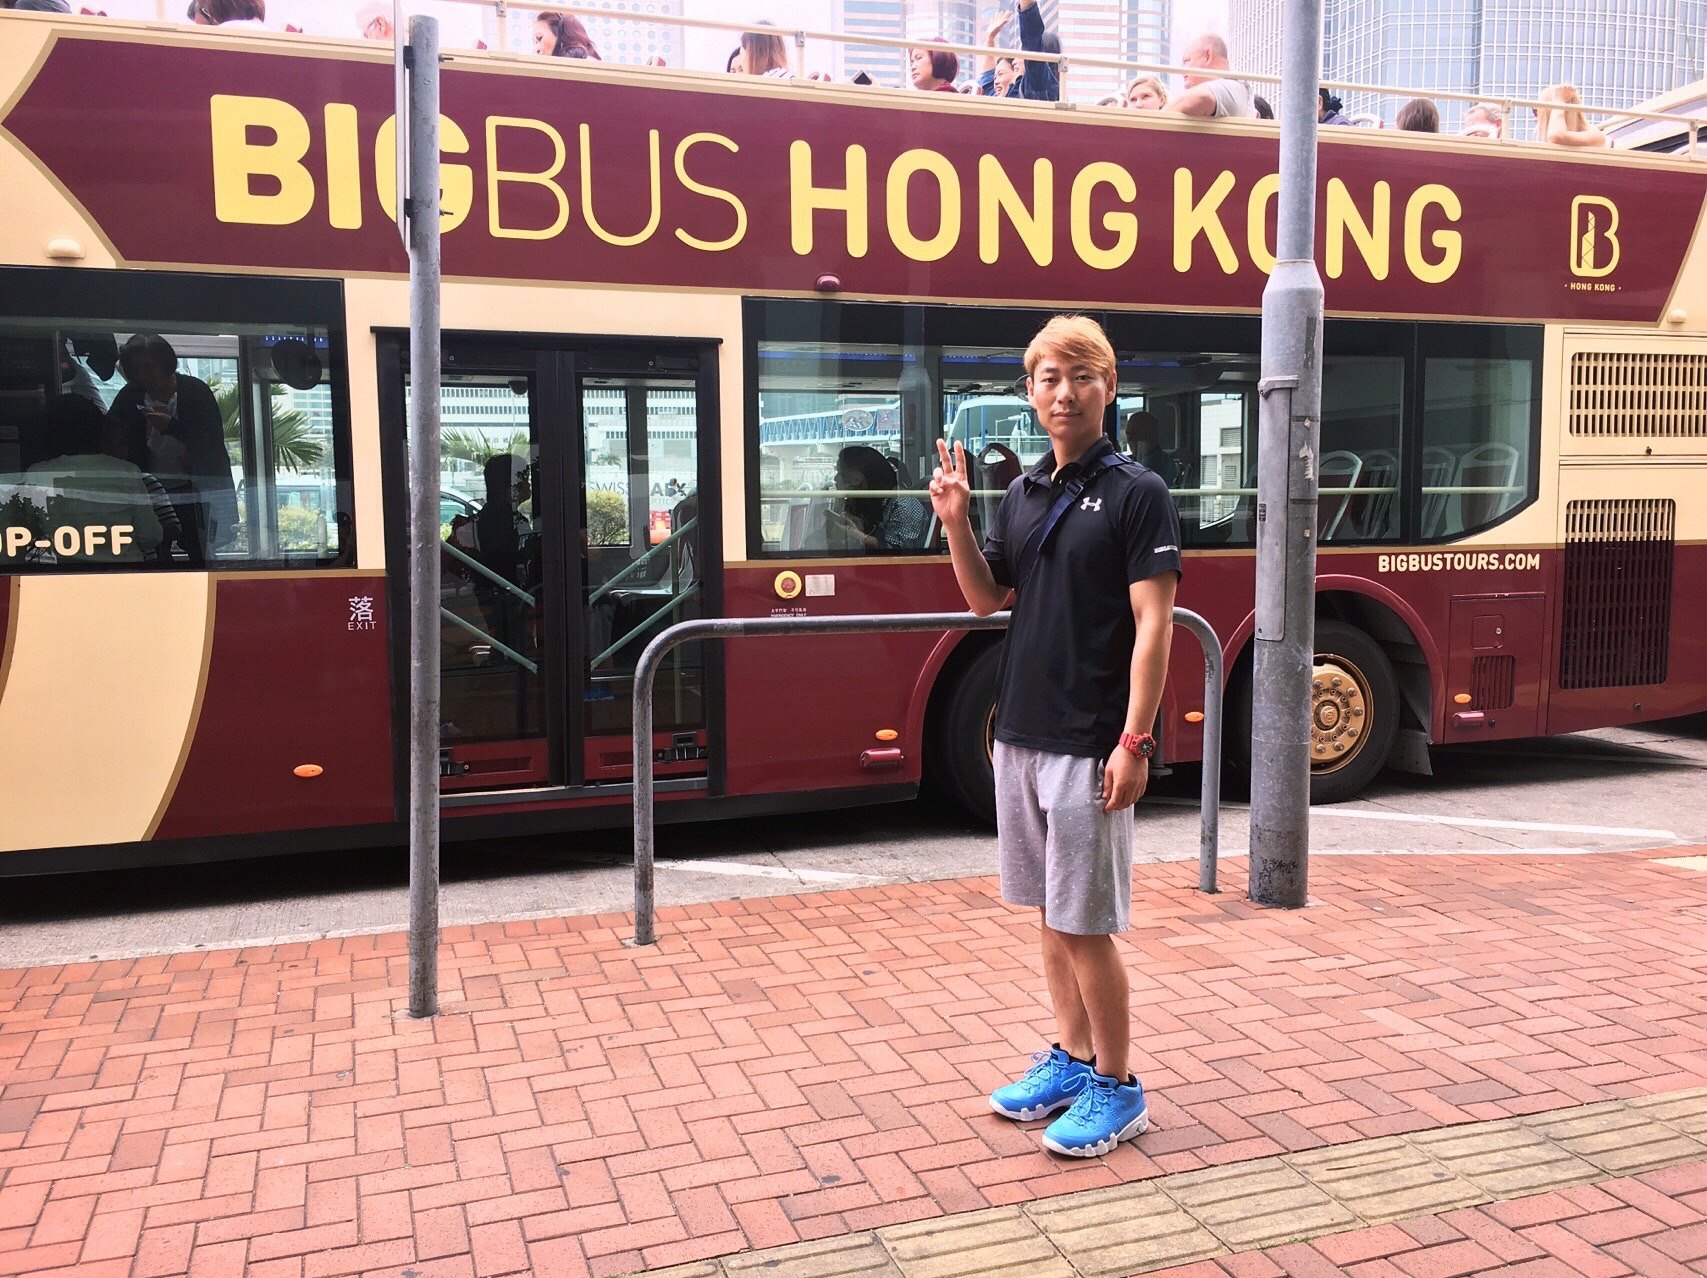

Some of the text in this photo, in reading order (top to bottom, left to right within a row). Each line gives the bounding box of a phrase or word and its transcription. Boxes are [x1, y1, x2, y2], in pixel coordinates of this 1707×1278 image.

[790, 139, 1138, 270] HONG
[1570, 282, 1616, 292] HONG KONG
[0, 525, 134, 557] P-OFF
[1378, 553, 1541, 573] BIGBUSTOURS.COM
[348, 596, 374, 622] 落
[347, 621, 377, 631] EXIT
